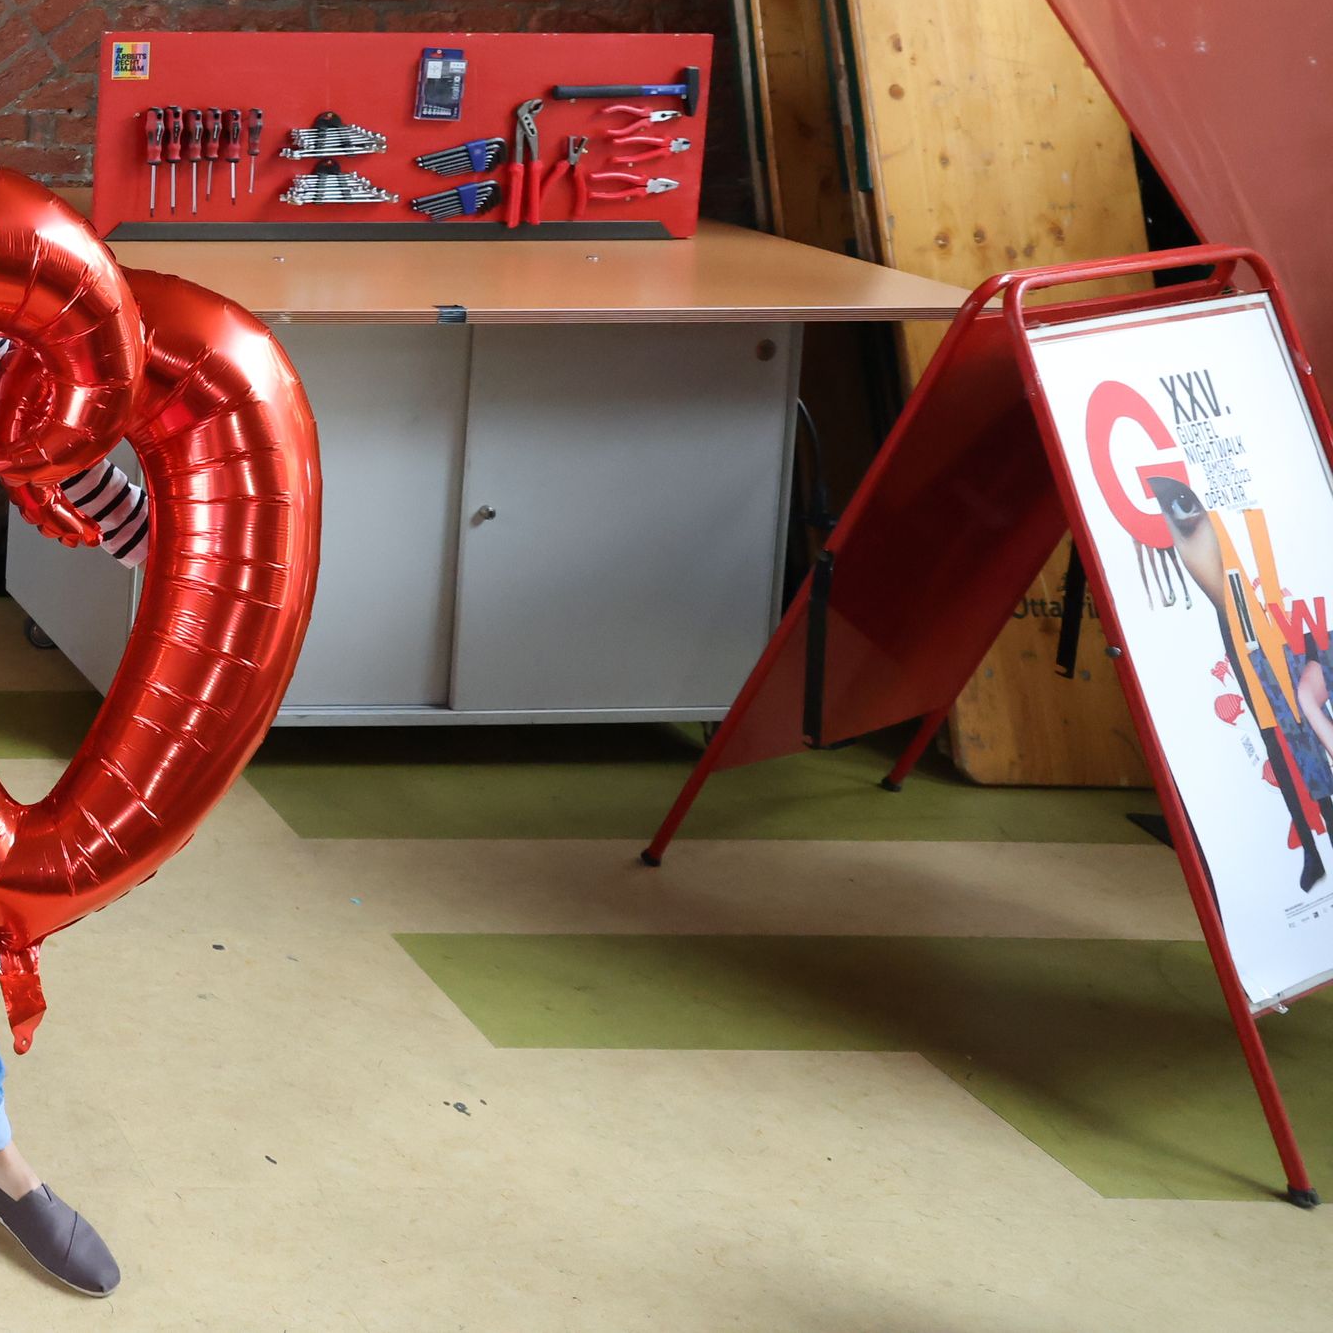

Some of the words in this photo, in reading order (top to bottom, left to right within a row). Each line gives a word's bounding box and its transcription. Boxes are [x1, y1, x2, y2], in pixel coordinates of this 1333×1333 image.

[1159, 369, 1231, 425] XXV.
[1184, 435, 1246, 465] NIGHTWALK
[1204, 489, 1231, 509] OPEN
[1230, 484, 1248, 503] AIR
